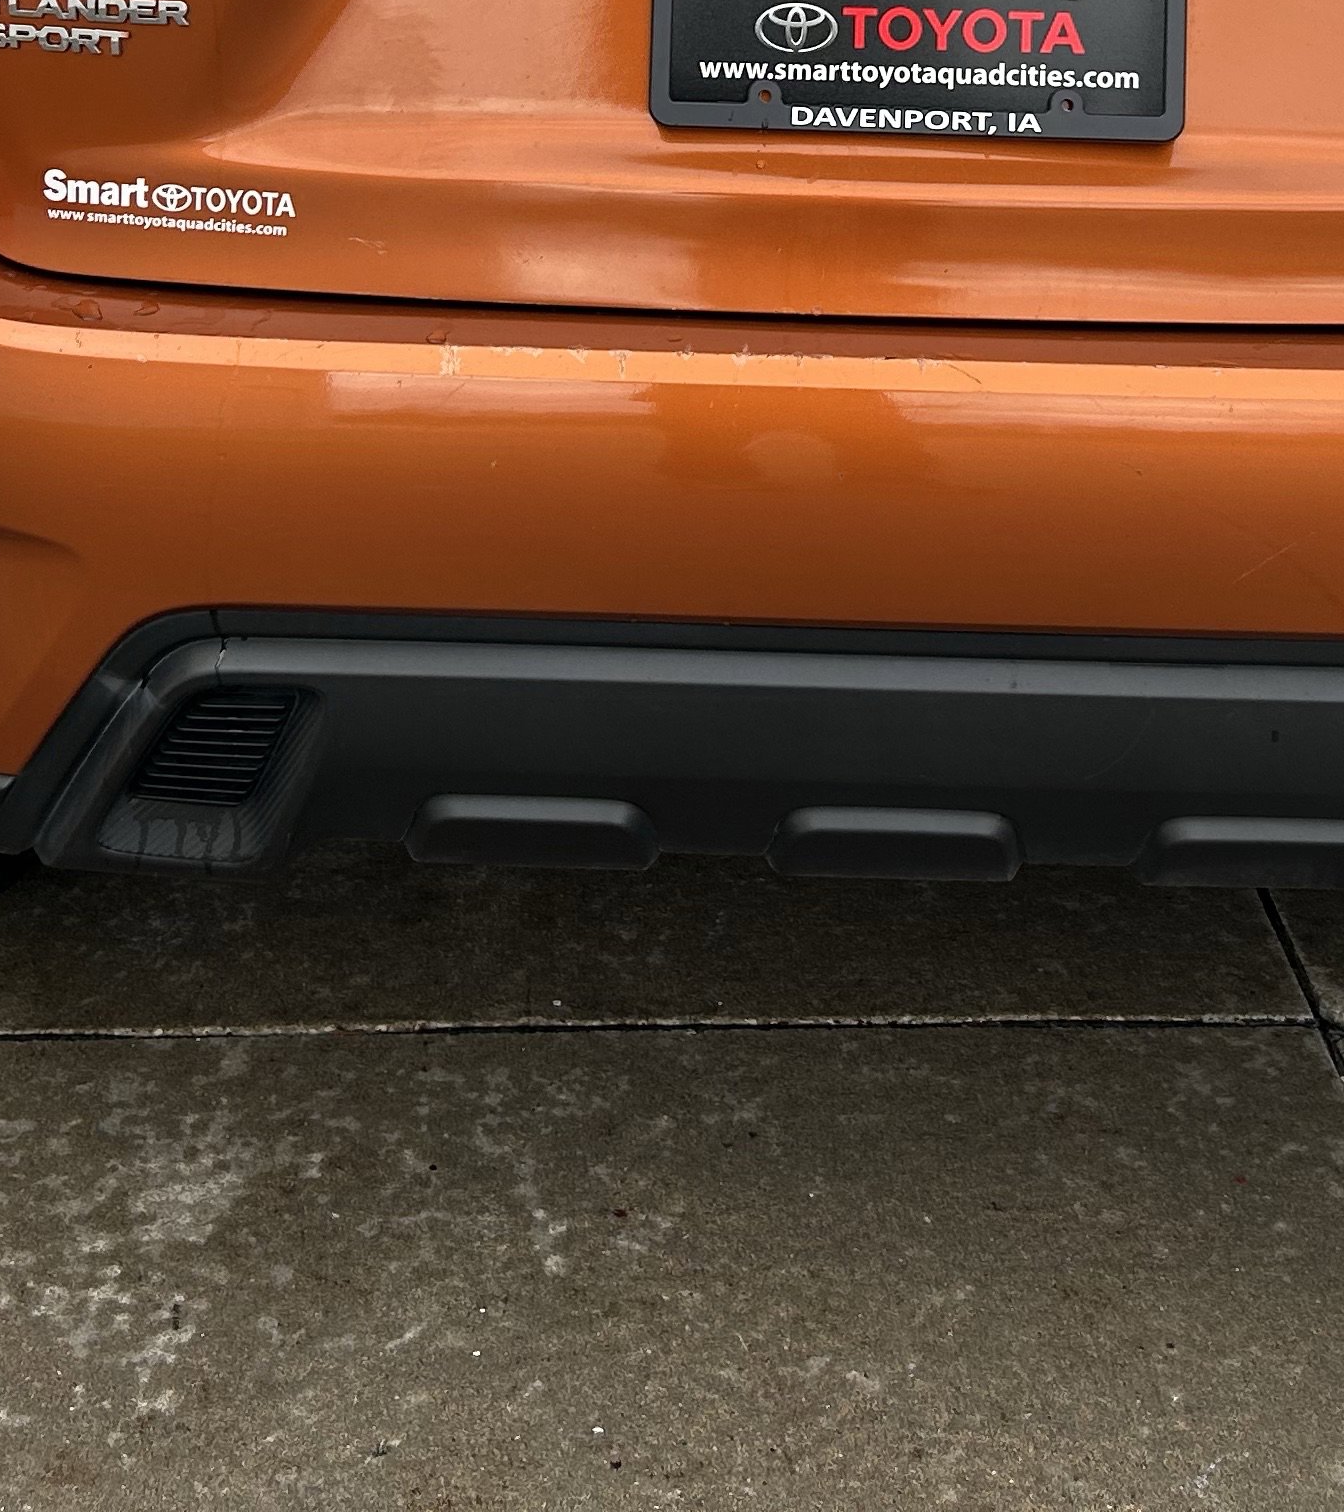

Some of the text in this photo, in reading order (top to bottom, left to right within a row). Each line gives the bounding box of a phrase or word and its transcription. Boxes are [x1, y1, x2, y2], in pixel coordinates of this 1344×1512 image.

[843, 6, 1085, 55] TOYOTA
[699, 59, 1140, 89] www.smarttoyotaquadcities.com
[791, 106, 1042, 135] DAVENPORT, IA
[43, 168, 296, 218] Smart TOYOTA
